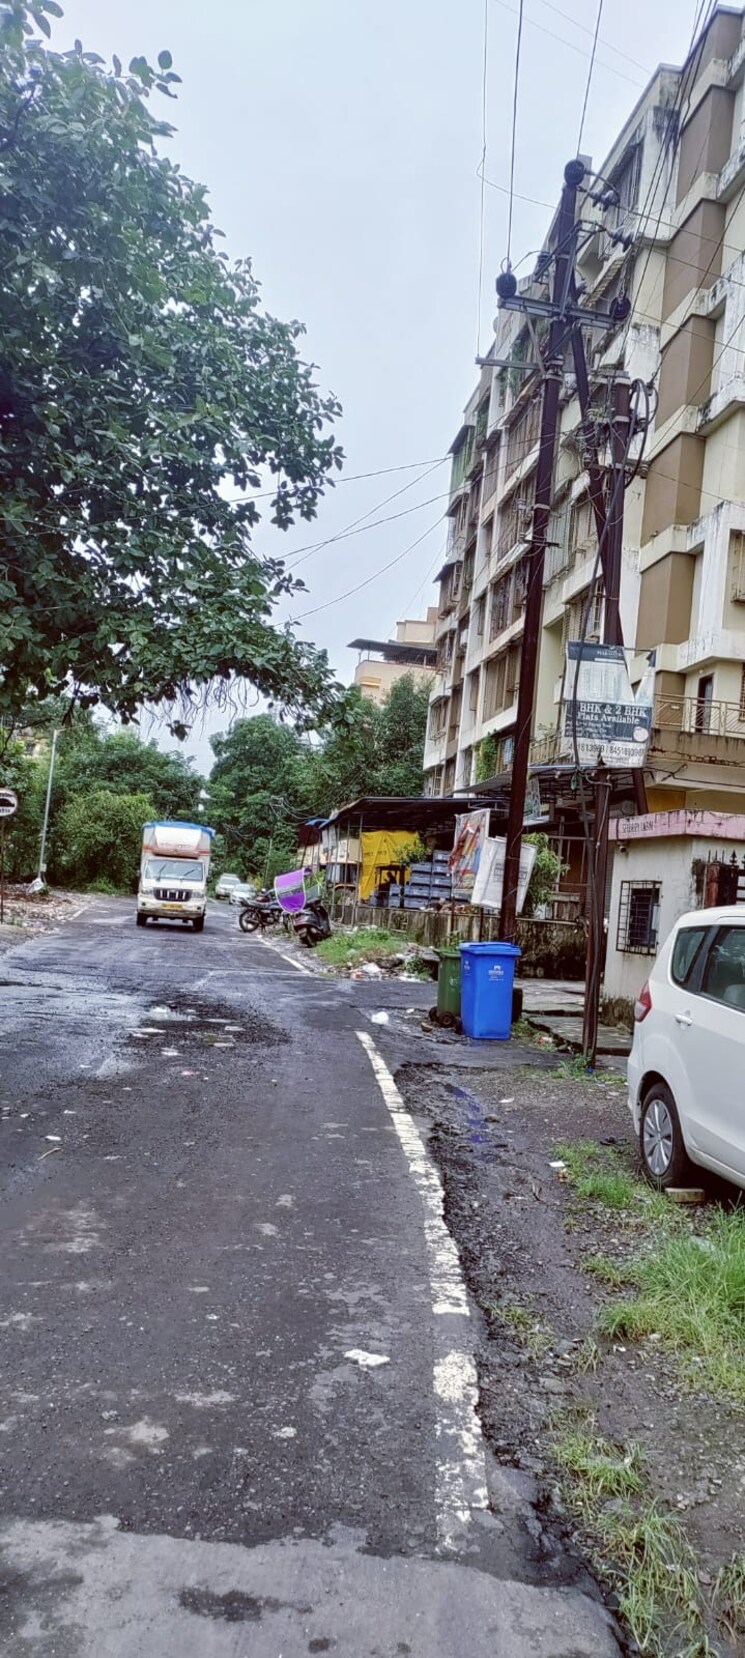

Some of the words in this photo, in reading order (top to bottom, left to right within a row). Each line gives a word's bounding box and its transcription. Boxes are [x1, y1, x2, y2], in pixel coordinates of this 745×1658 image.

[580, 703, 602, 714] BHK
[604, 705, 612, 714] &
[616, 706, 621, 714] 2
[624, 706, 647, 717] BHK
[577, 712, 598, 721] Flats
[601, 713, 640, 724] Available
